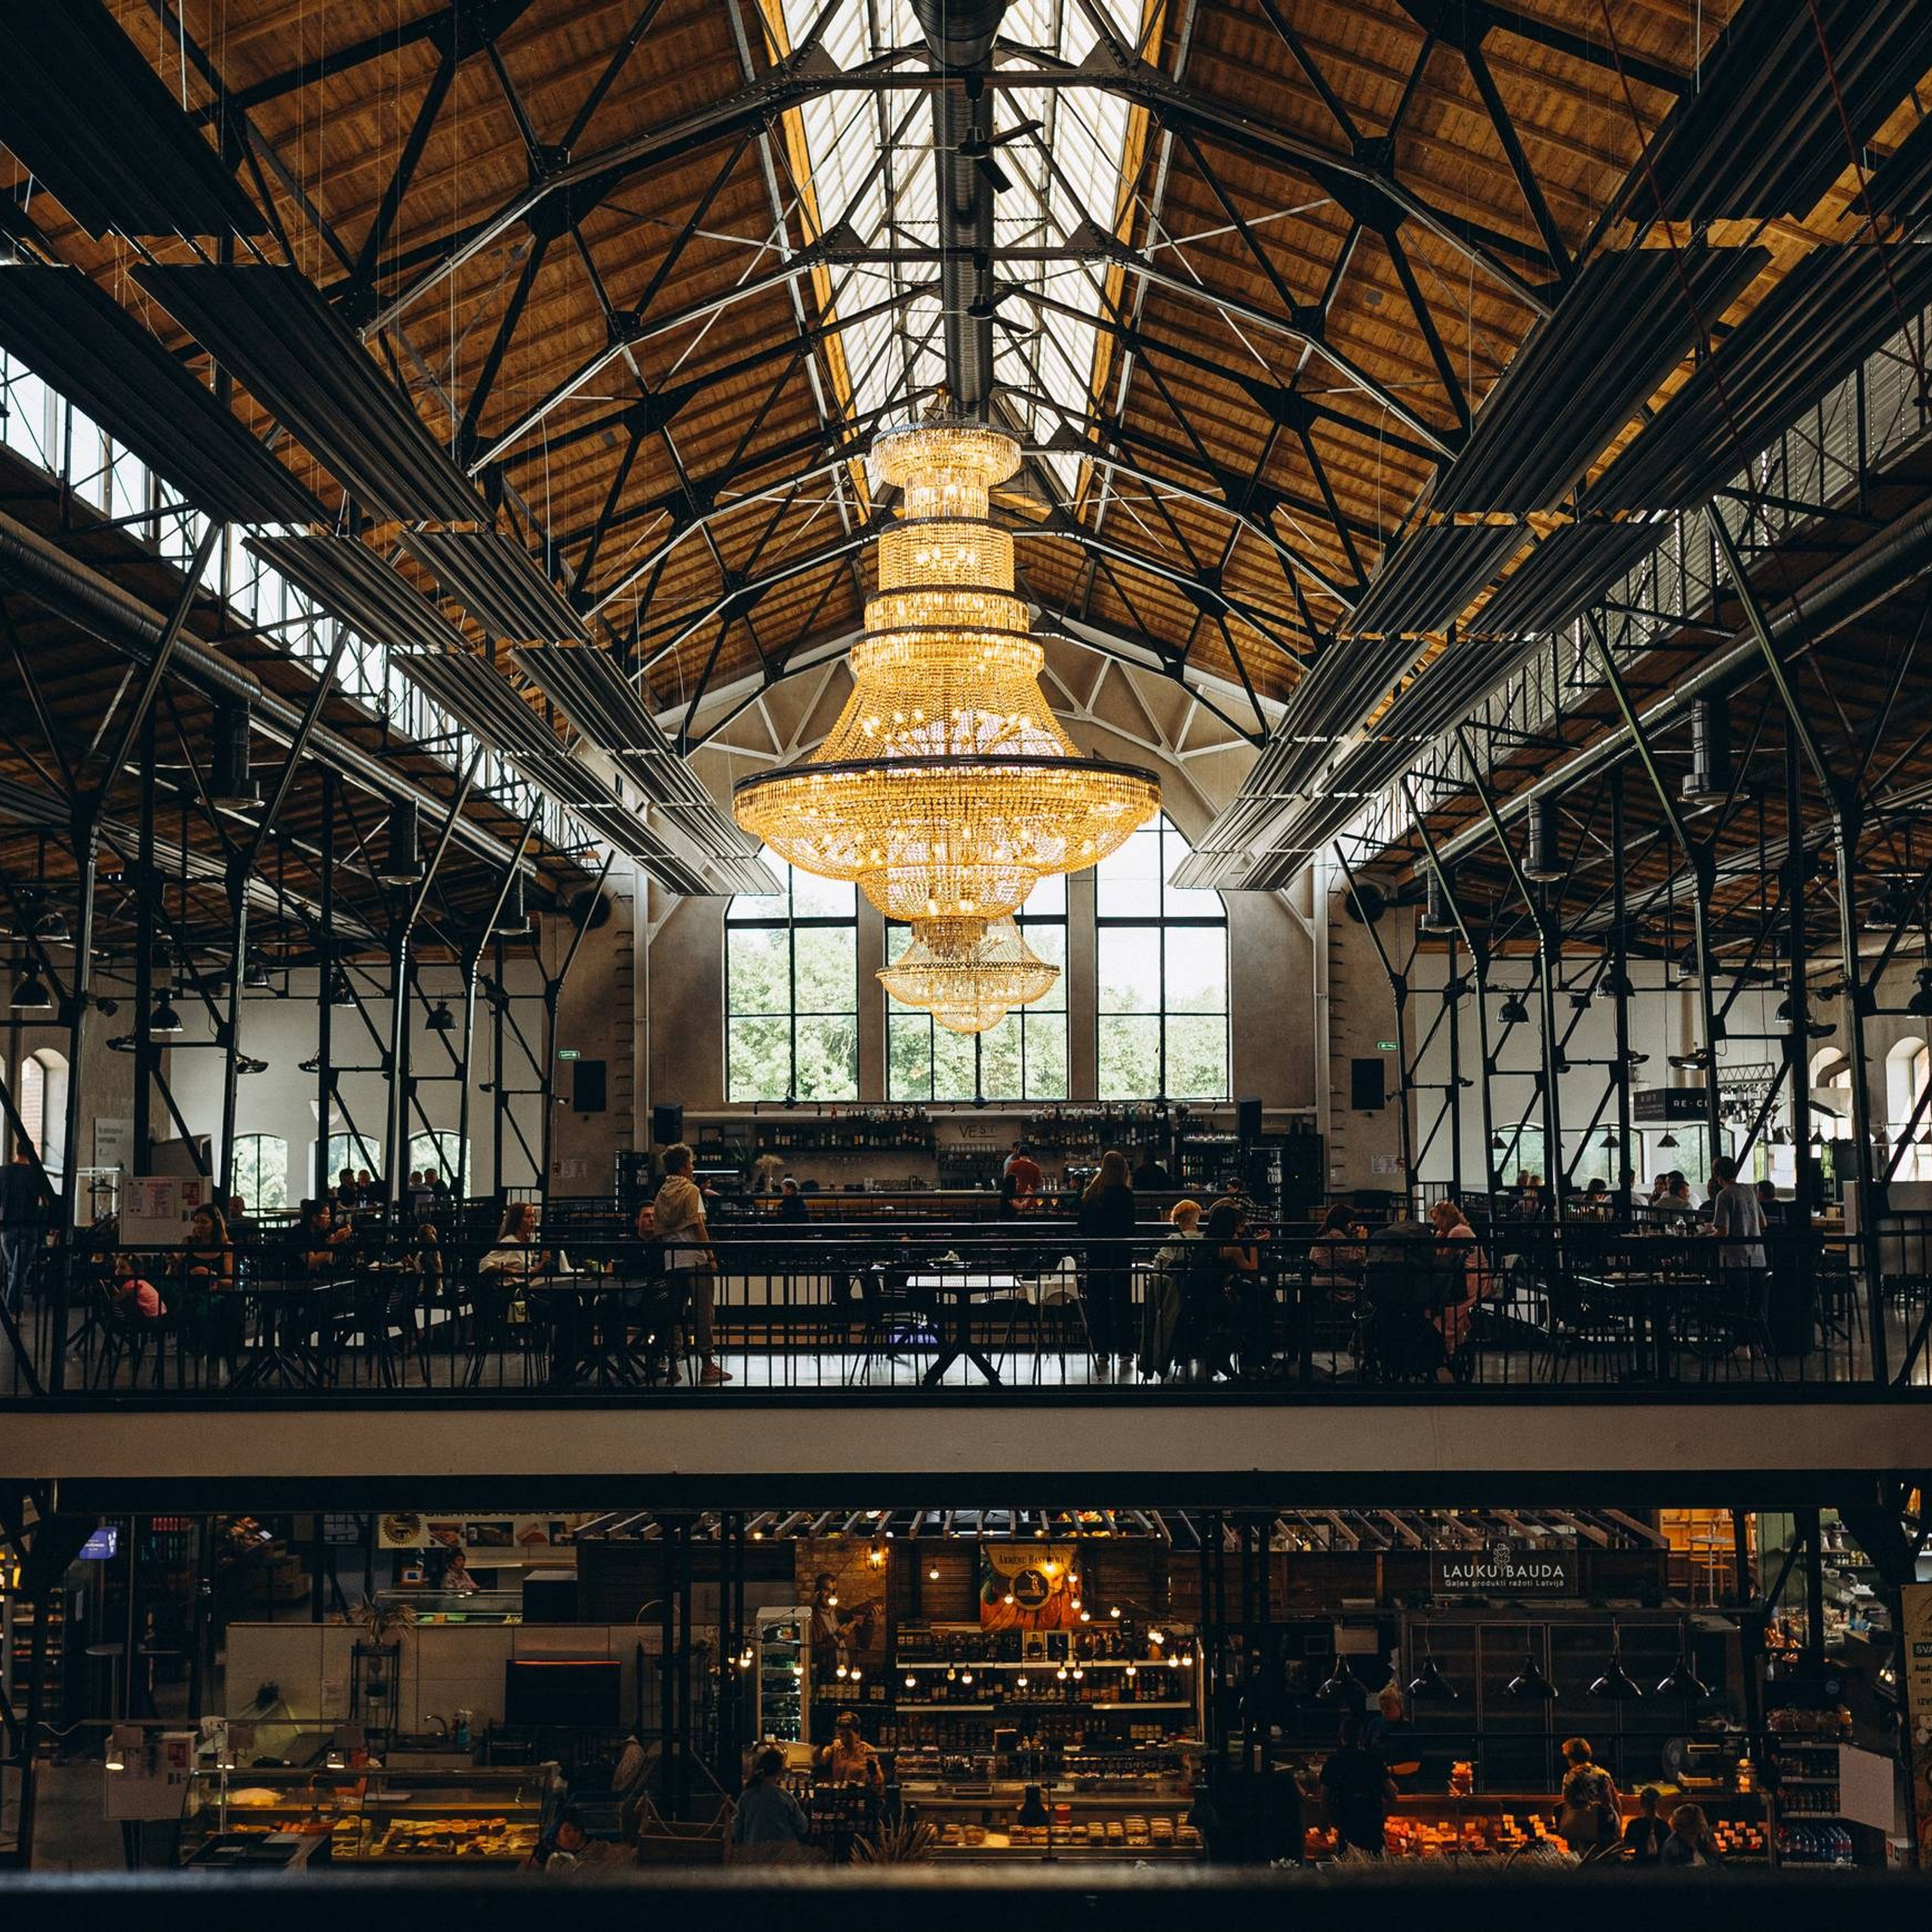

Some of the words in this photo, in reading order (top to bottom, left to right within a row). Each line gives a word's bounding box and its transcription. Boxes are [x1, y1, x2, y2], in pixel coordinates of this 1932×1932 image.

[1443, 1564, 1497, 1578] LAUKU
[1506, 1564, 1564, 1578] BAUDA
[1472, 1580, 1506, 1588] produkti
[1536, 1580, 1564, 1589] Latvijā
